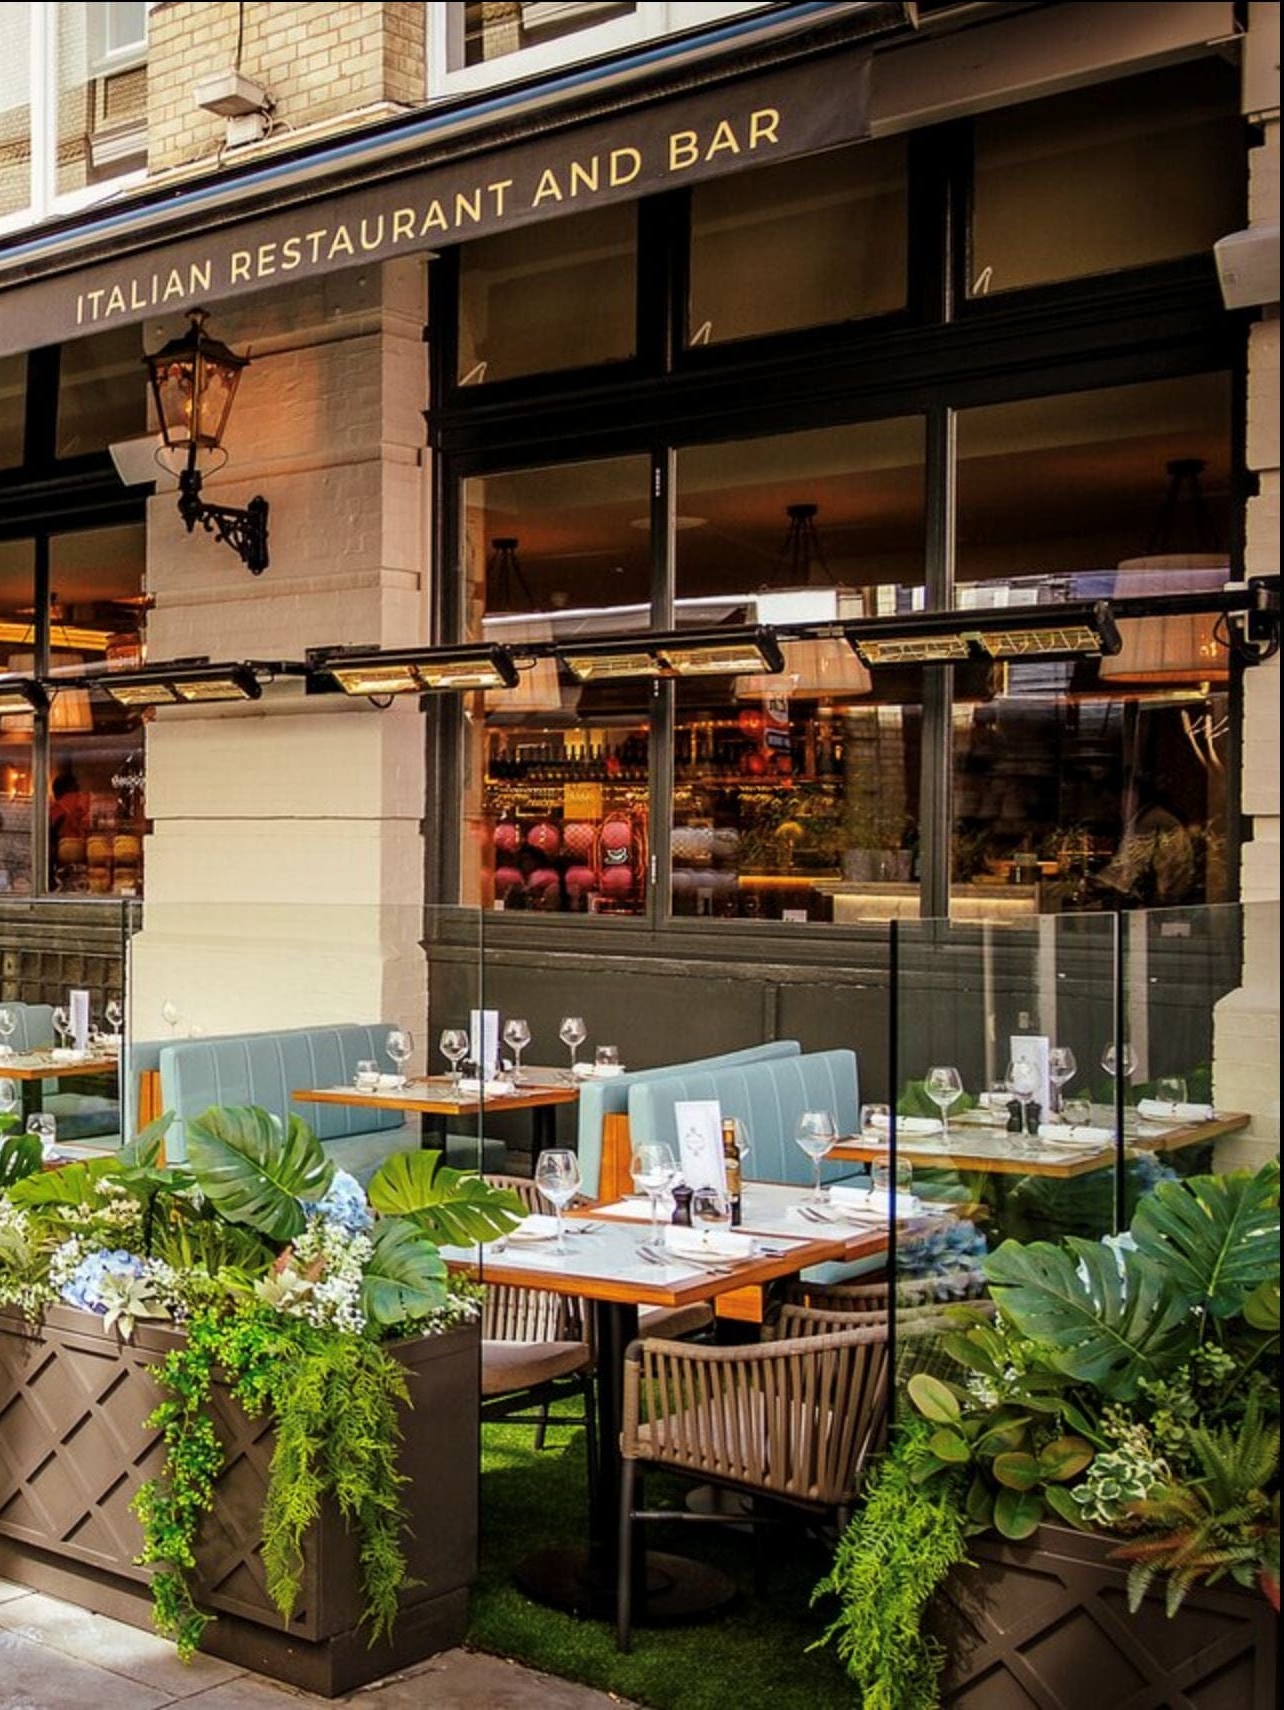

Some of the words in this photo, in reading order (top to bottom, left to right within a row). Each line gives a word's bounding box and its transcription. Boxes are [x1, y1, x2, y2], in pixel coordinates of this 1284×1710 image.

[76, 260, 212, 324] ITALIAN
[230, 179, 513, 284] RESTAURANT
[532, 147, 642, 207] AND
[668, 108, 781, 171] BAR
